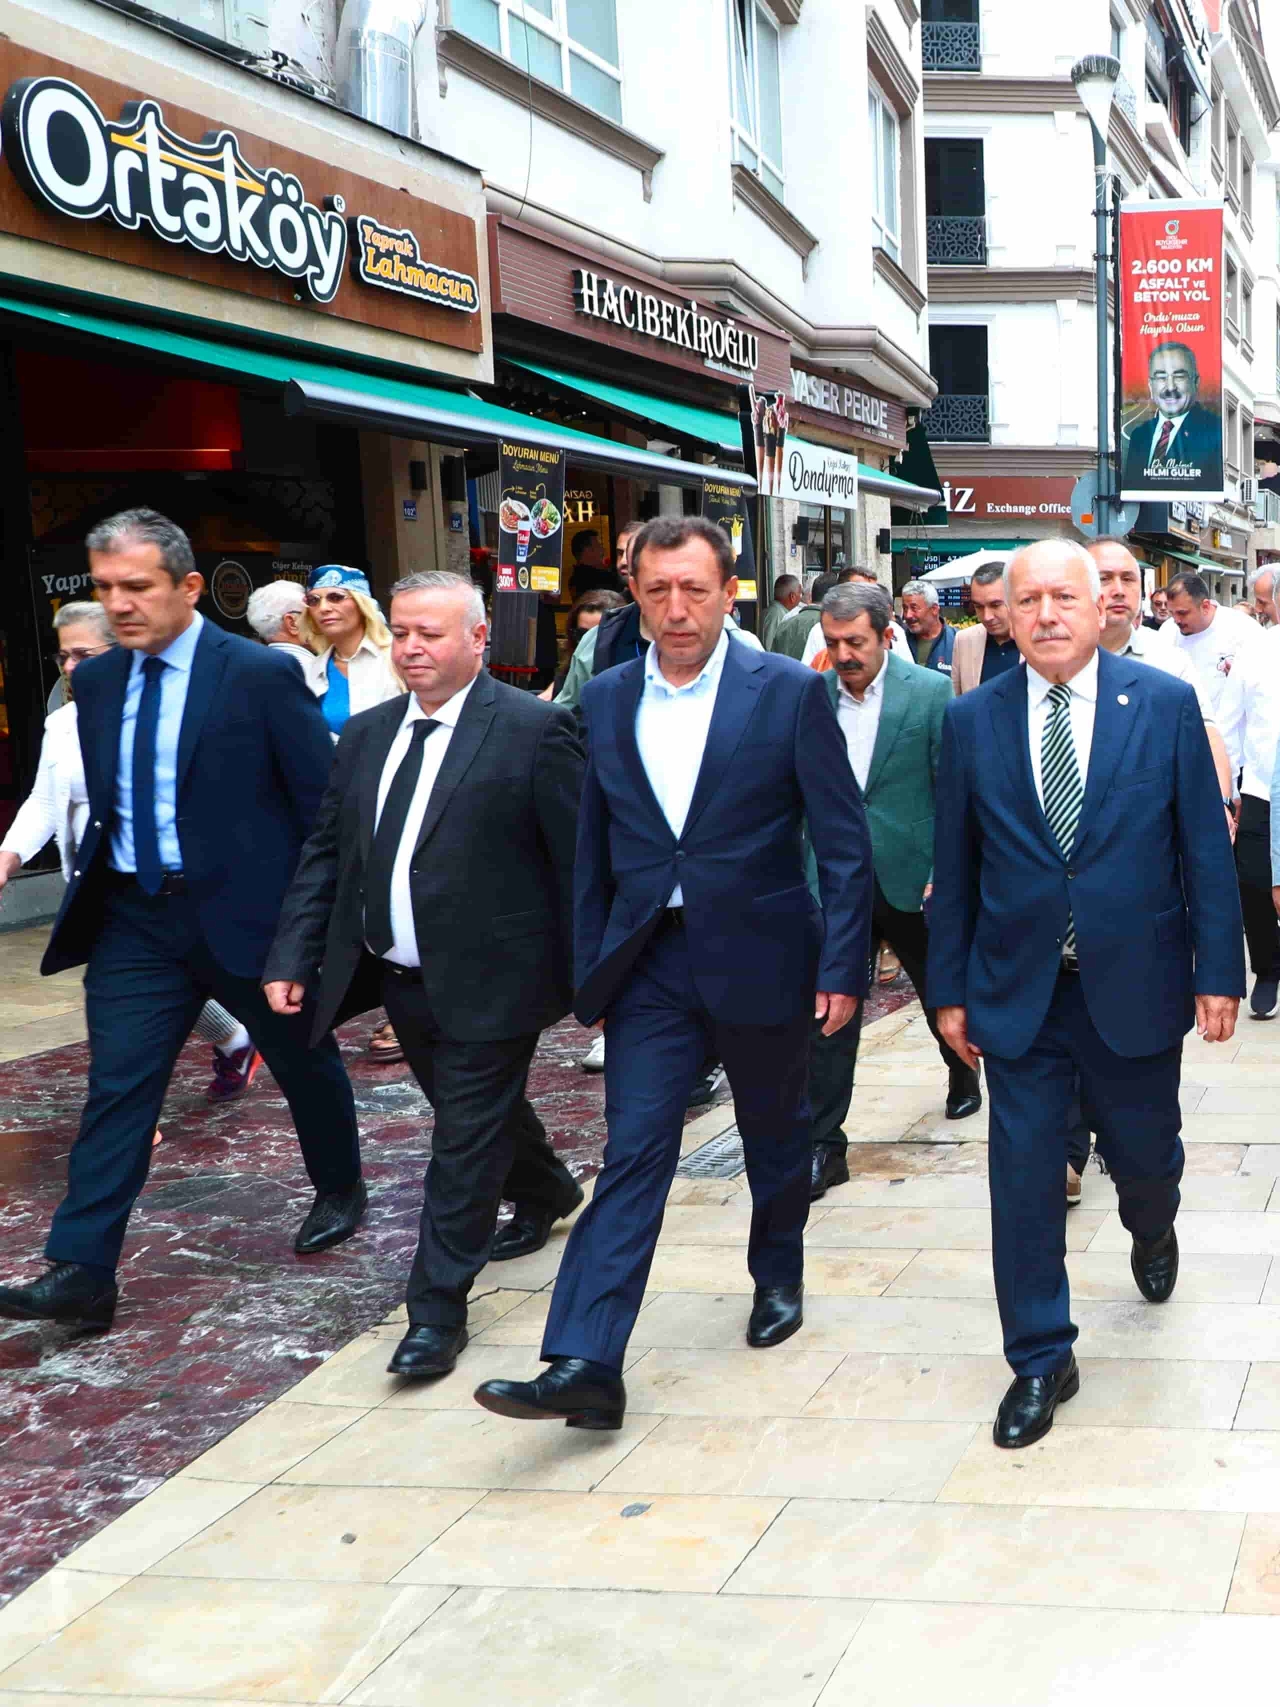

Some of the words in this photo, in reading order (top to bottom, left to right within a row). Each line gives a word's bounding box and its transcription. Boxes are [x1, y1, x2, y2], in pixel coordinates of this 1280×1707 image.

[26, 87, 342, 293] Ortaköy
[362, 224, 414, 257] Yaprak
[365, 248, 474, 302] Lahmacun
[1131, 259, 1182, 275] 2.600
[1186, 258, 1213, 272] KM
[1139, 277, 1190, 290] ASFALT
[1193, 280, 1205, 288] VE
[1133, 291, 1179, 303] BETON
[1183, 290, 1210, 301] YOL
[580, 268, 759, 371] HACIBEKİROĞLU
[1143, 311, 1200, 322] Ordu'muza
[1175, 322, 1205, 333] Olsun
[790, 368, 841, 415] YASER
[843, 387, 888, 430] PERDE
[502, 443, 539, 462] DOYURAN
[540, 452, 560, 465] MENÜ
[789, 451, 854, 500] Dondurma
[986, 502, 1036, 516] Exchange
[1039, 502, 1072, 513] Office
[41, 572, 97, 596] Yapr
